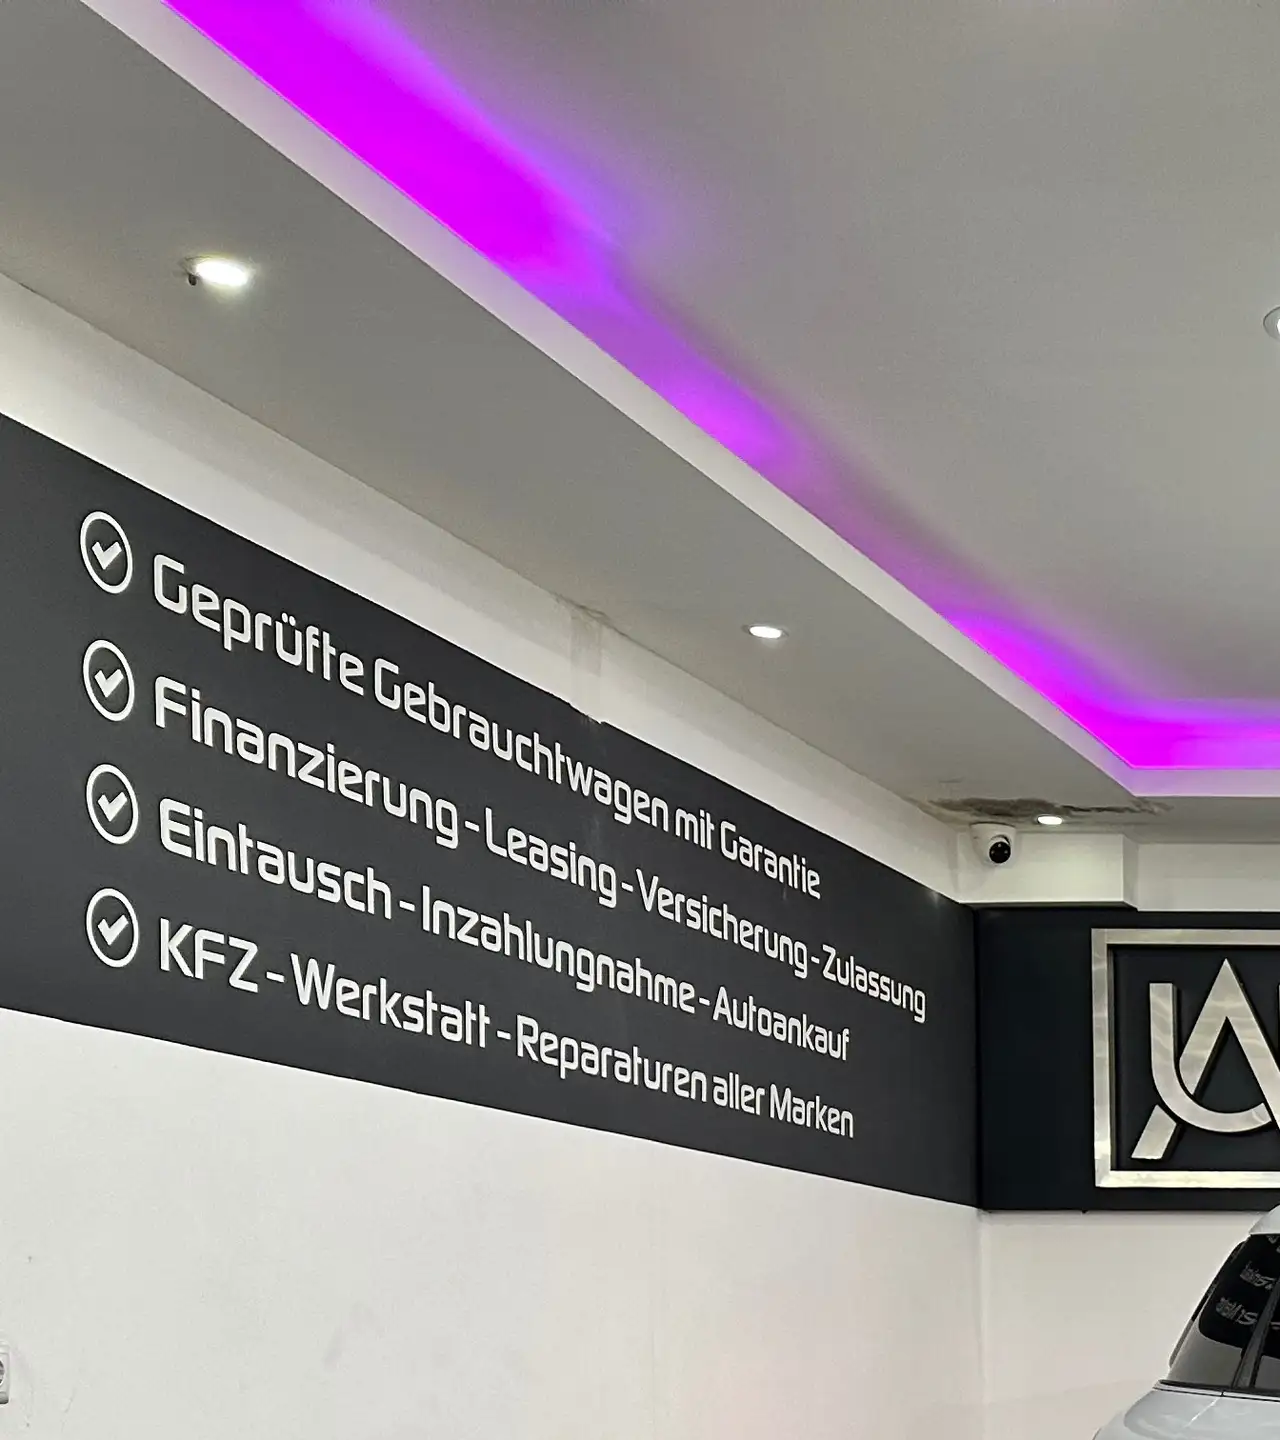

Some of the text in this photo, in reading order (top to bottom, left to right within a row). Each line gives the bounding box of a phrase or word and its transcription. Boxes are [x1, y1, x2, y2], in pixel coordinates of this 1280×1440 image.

[153, 554, 821, 900] Geprüfte Gebrauchtwagen mit Garantie
[713, 1072, 765, 1116] aller
[770, 1083, 854, 1138] Marken
